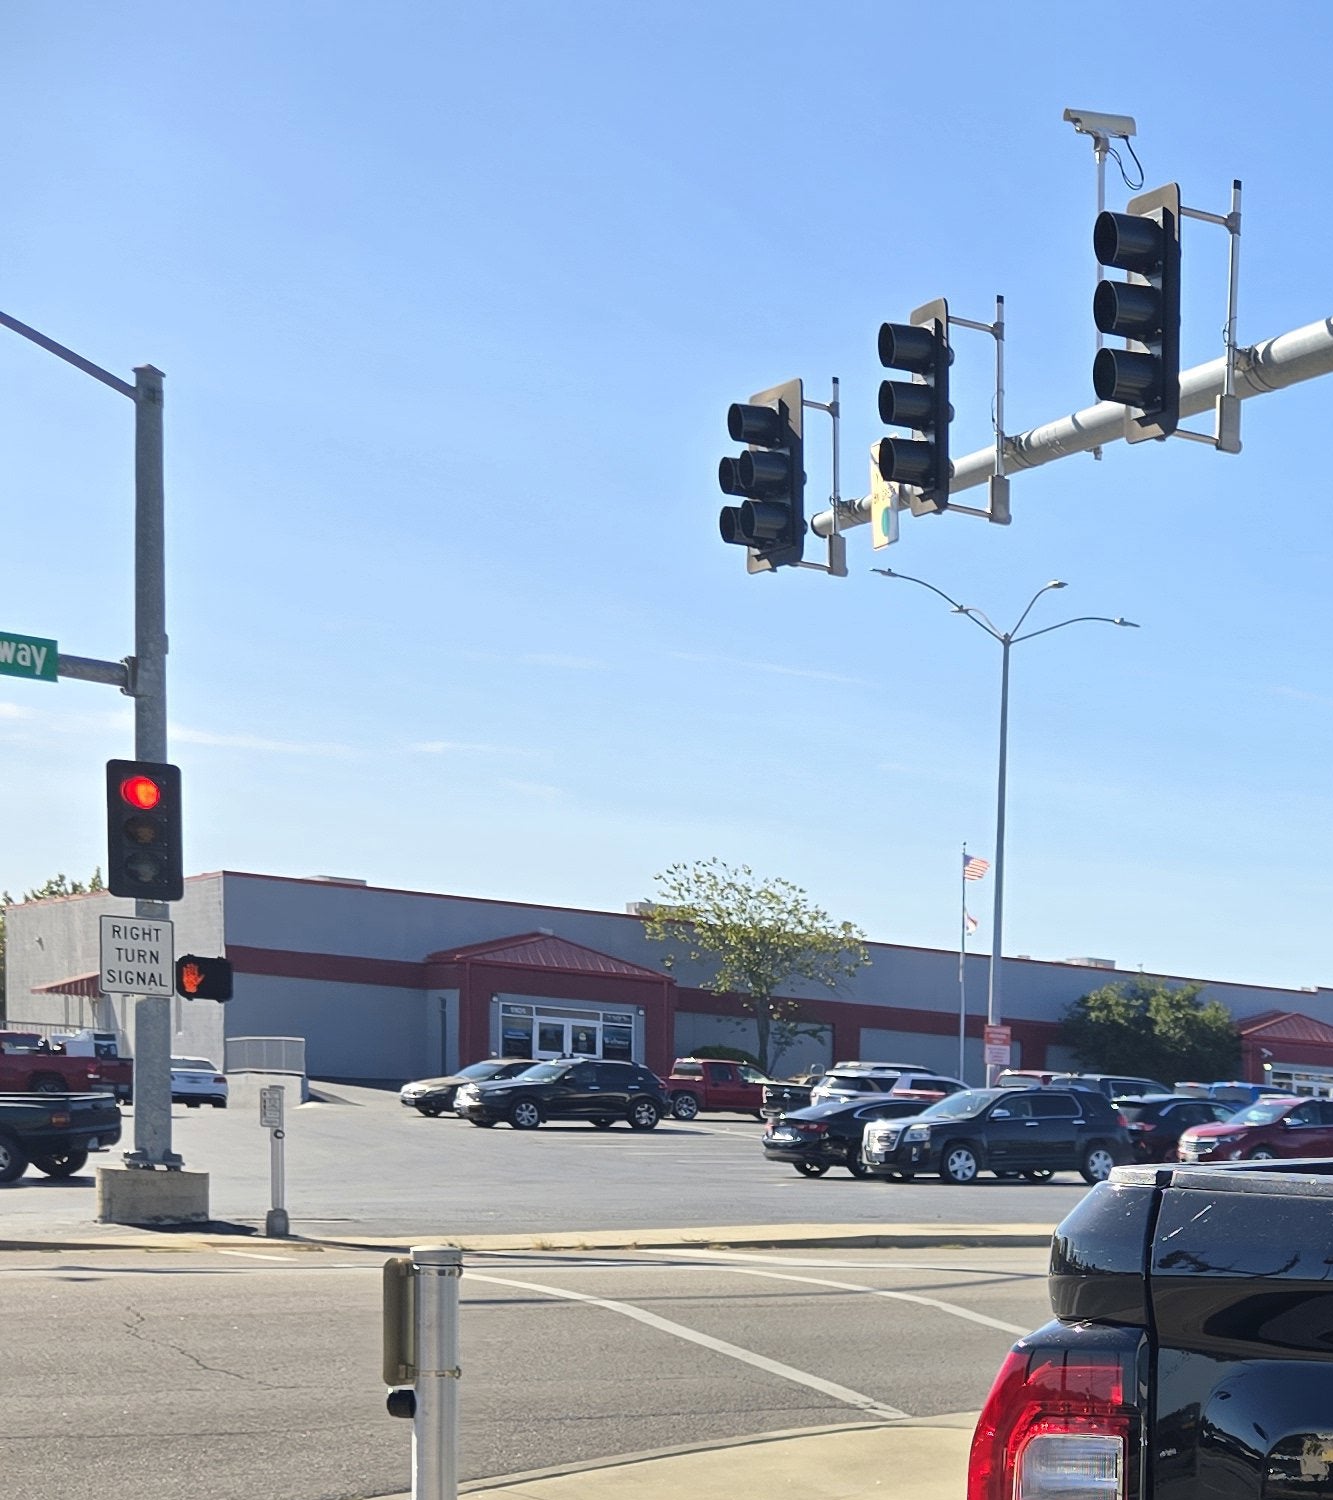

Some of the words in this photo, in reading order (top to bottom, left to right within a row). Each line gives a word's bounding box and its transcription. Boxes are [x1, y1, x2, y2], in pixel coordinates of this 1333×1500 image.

[112, 925, 162, 942] RIGHT
[115, 947, 159, 964] TURN
[106, 969, 168, 987] SIGNAL
